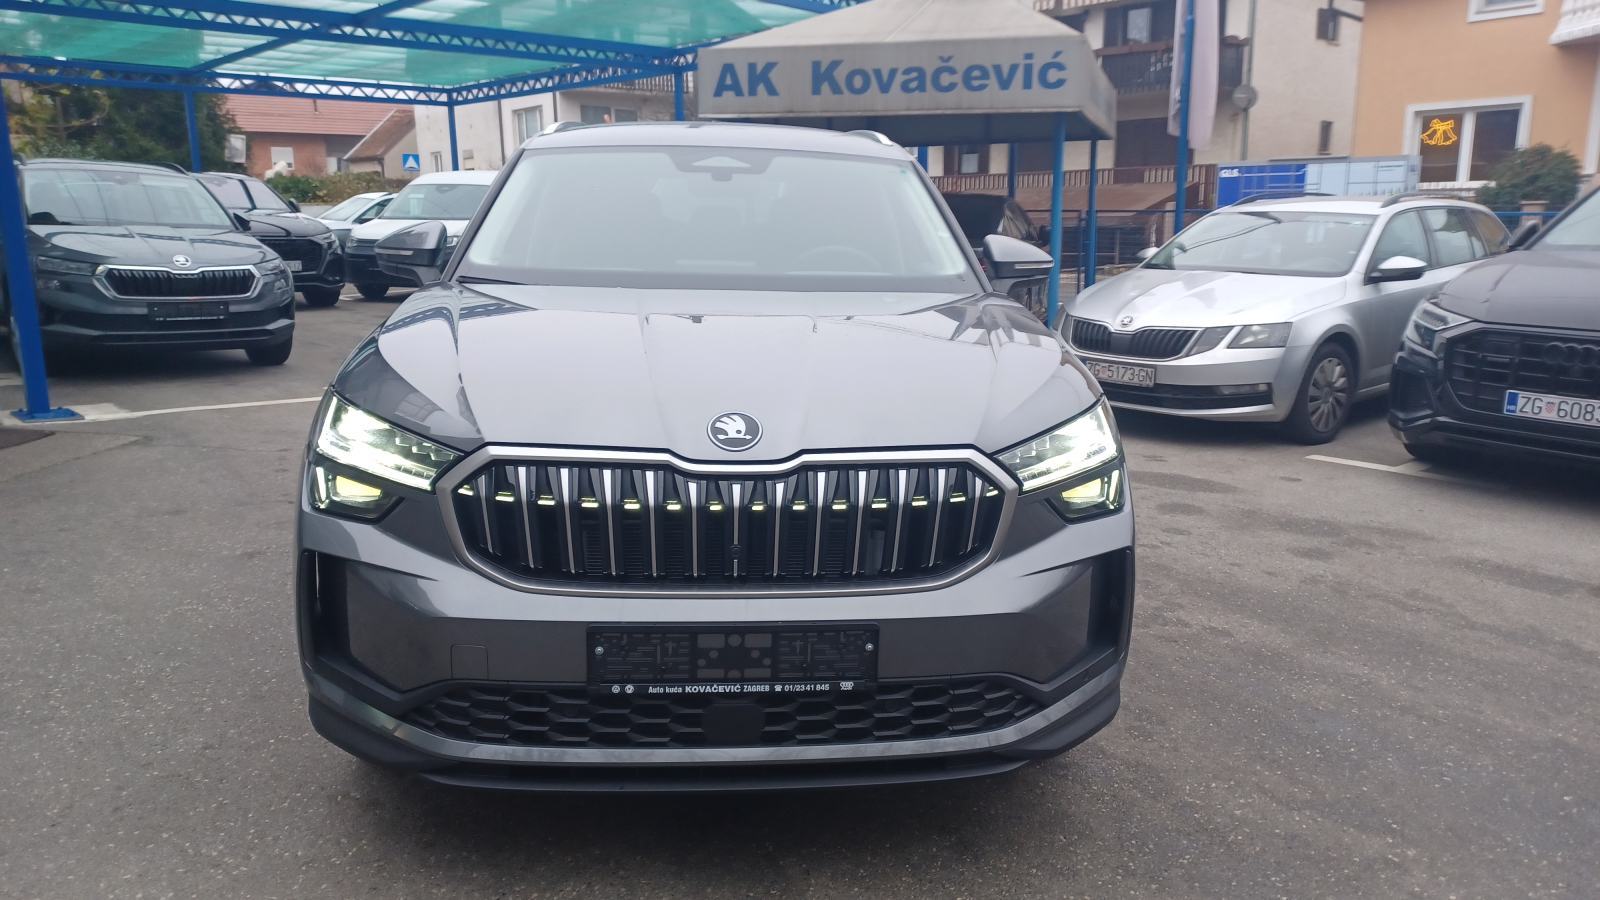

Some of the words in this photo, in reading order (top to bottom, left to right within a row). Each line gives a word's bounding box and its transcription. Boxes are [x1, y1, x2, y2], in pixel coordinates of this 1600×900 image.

[713, 62, 780, 98] AK
[811, 51, 1068, 97] Kovačević
[1519, 396, 1544, 415] ZG
[648, 686, 664, 694] Auto
[685, 683, 742, 693] KOVAČEVIĆ
[743, 684, 770, 692] ZAGREB
[815, 683, 830, 691] 845
